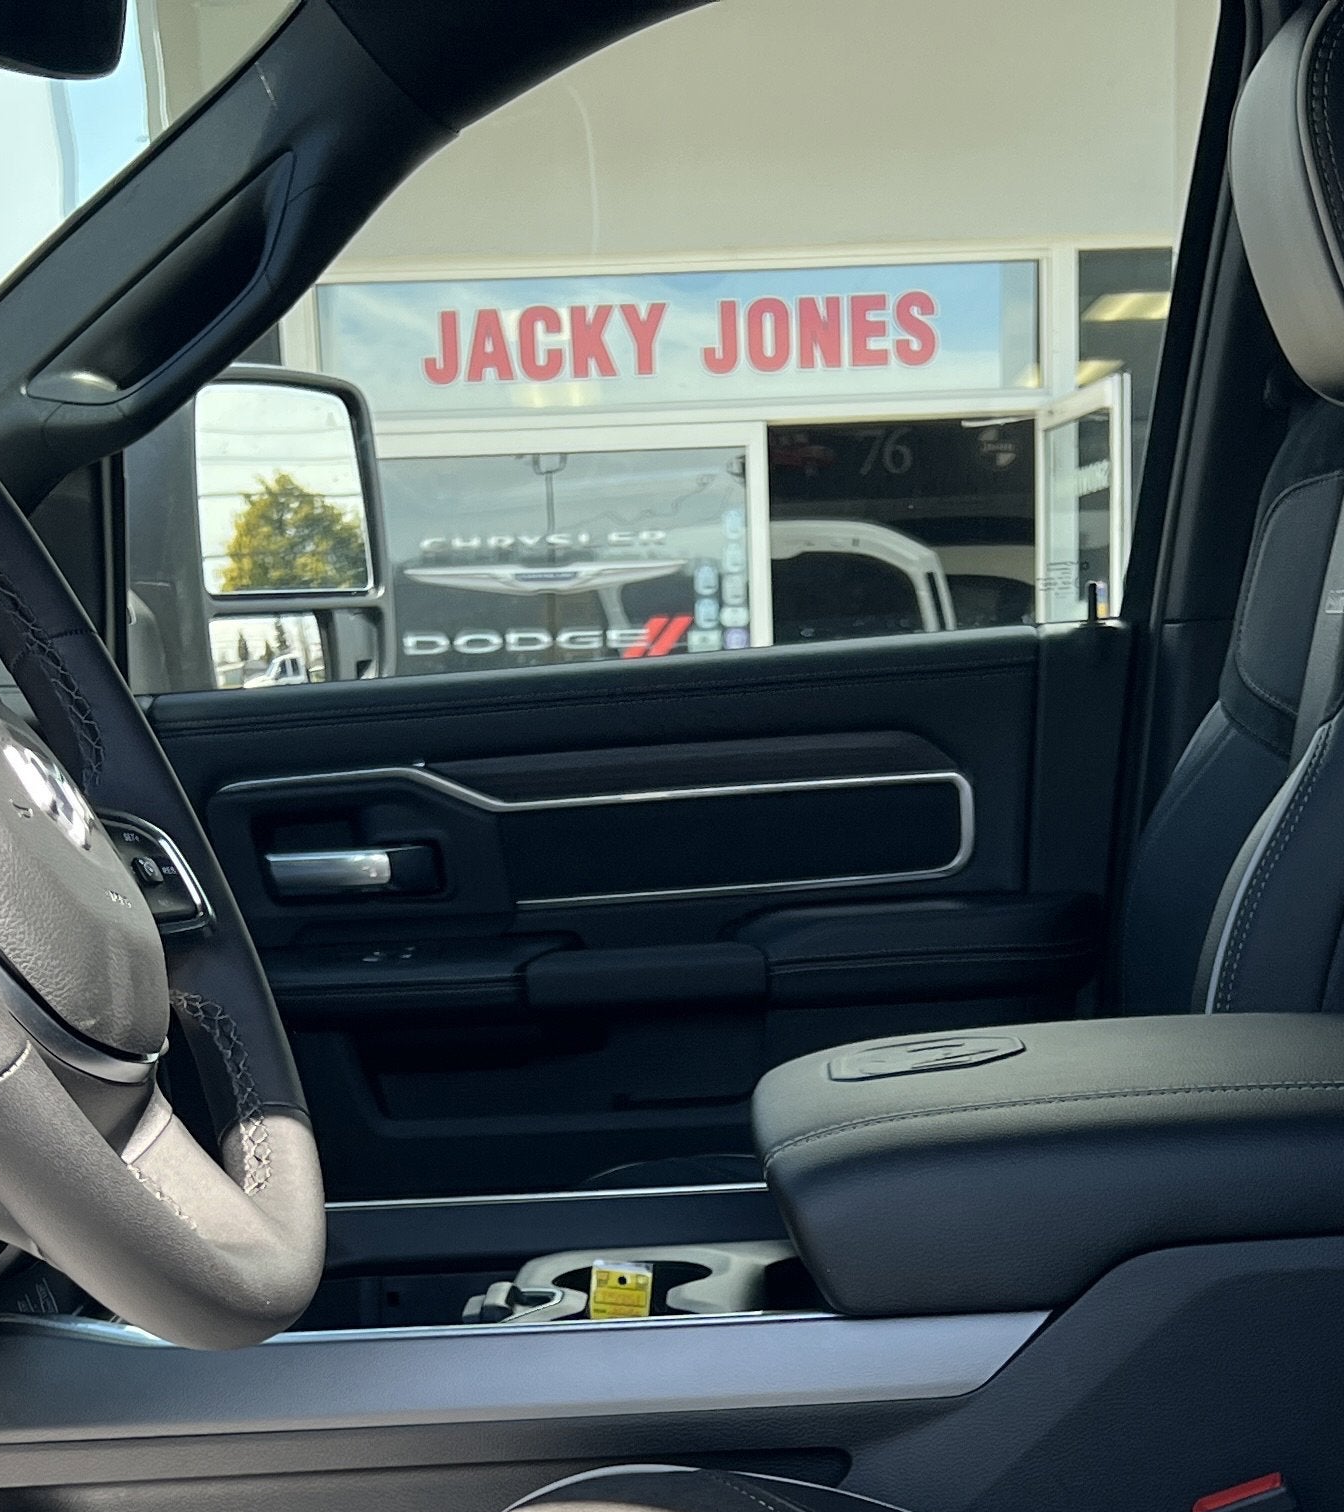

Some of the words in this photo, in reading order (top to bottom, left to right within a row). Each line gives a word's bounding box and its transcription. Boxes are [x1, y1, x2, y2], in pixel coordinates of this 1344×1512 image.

[423, 303, 667, 385] JACKY
[703, 290, 938, 374] JONES
[420, 529, 666, 550] CHRYSLER
[403, 628, 650, 655] DODGE
